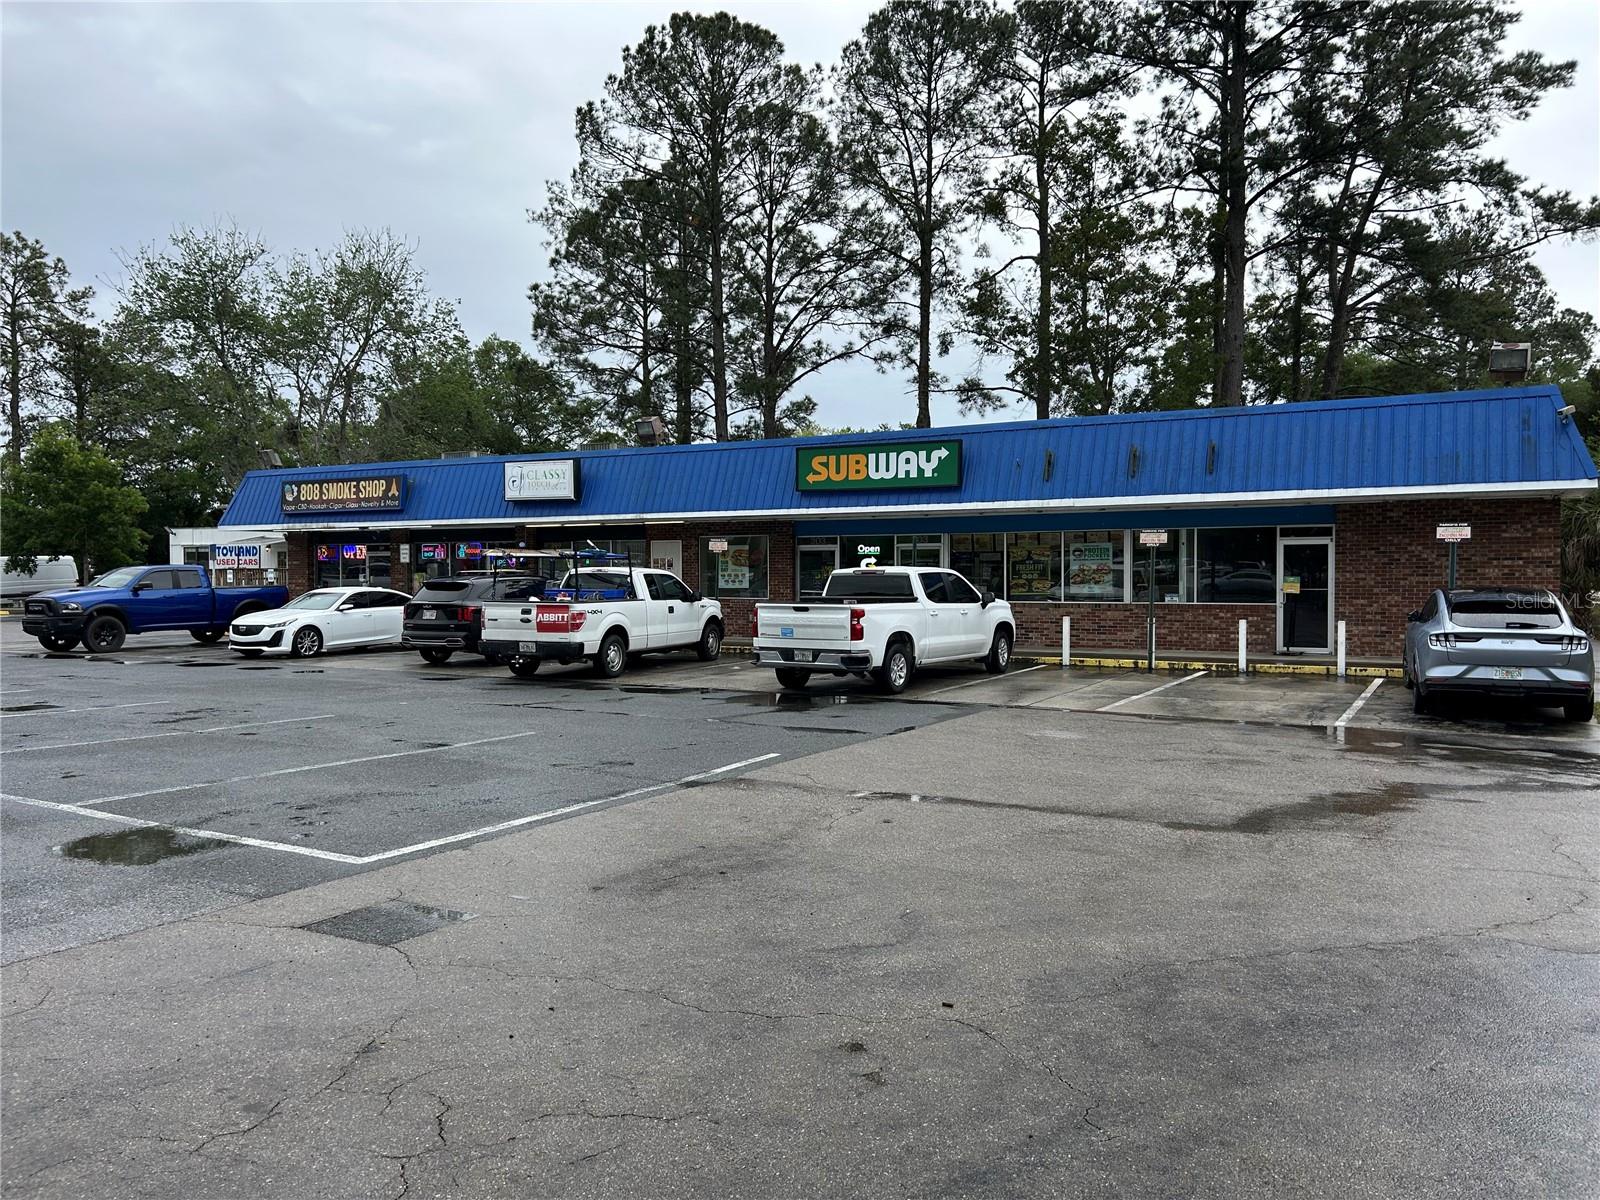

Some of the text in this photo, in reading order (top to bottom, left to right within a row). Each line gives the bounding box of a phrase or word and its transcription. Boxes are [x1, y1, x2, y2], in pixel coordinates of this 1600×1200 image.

[806, 446, 950, 484] SUBWAY
[527, 468, 568, 480] CLASSY
[300, 479, 386, 501] 808 SMOKE SHOP
[216, 546, 258, 557] TOYLAND
[857, 544, 880, 554] Open
[216, 558, 258, 566] USED CARS
[536, 613, 569, 623] ABBITT
